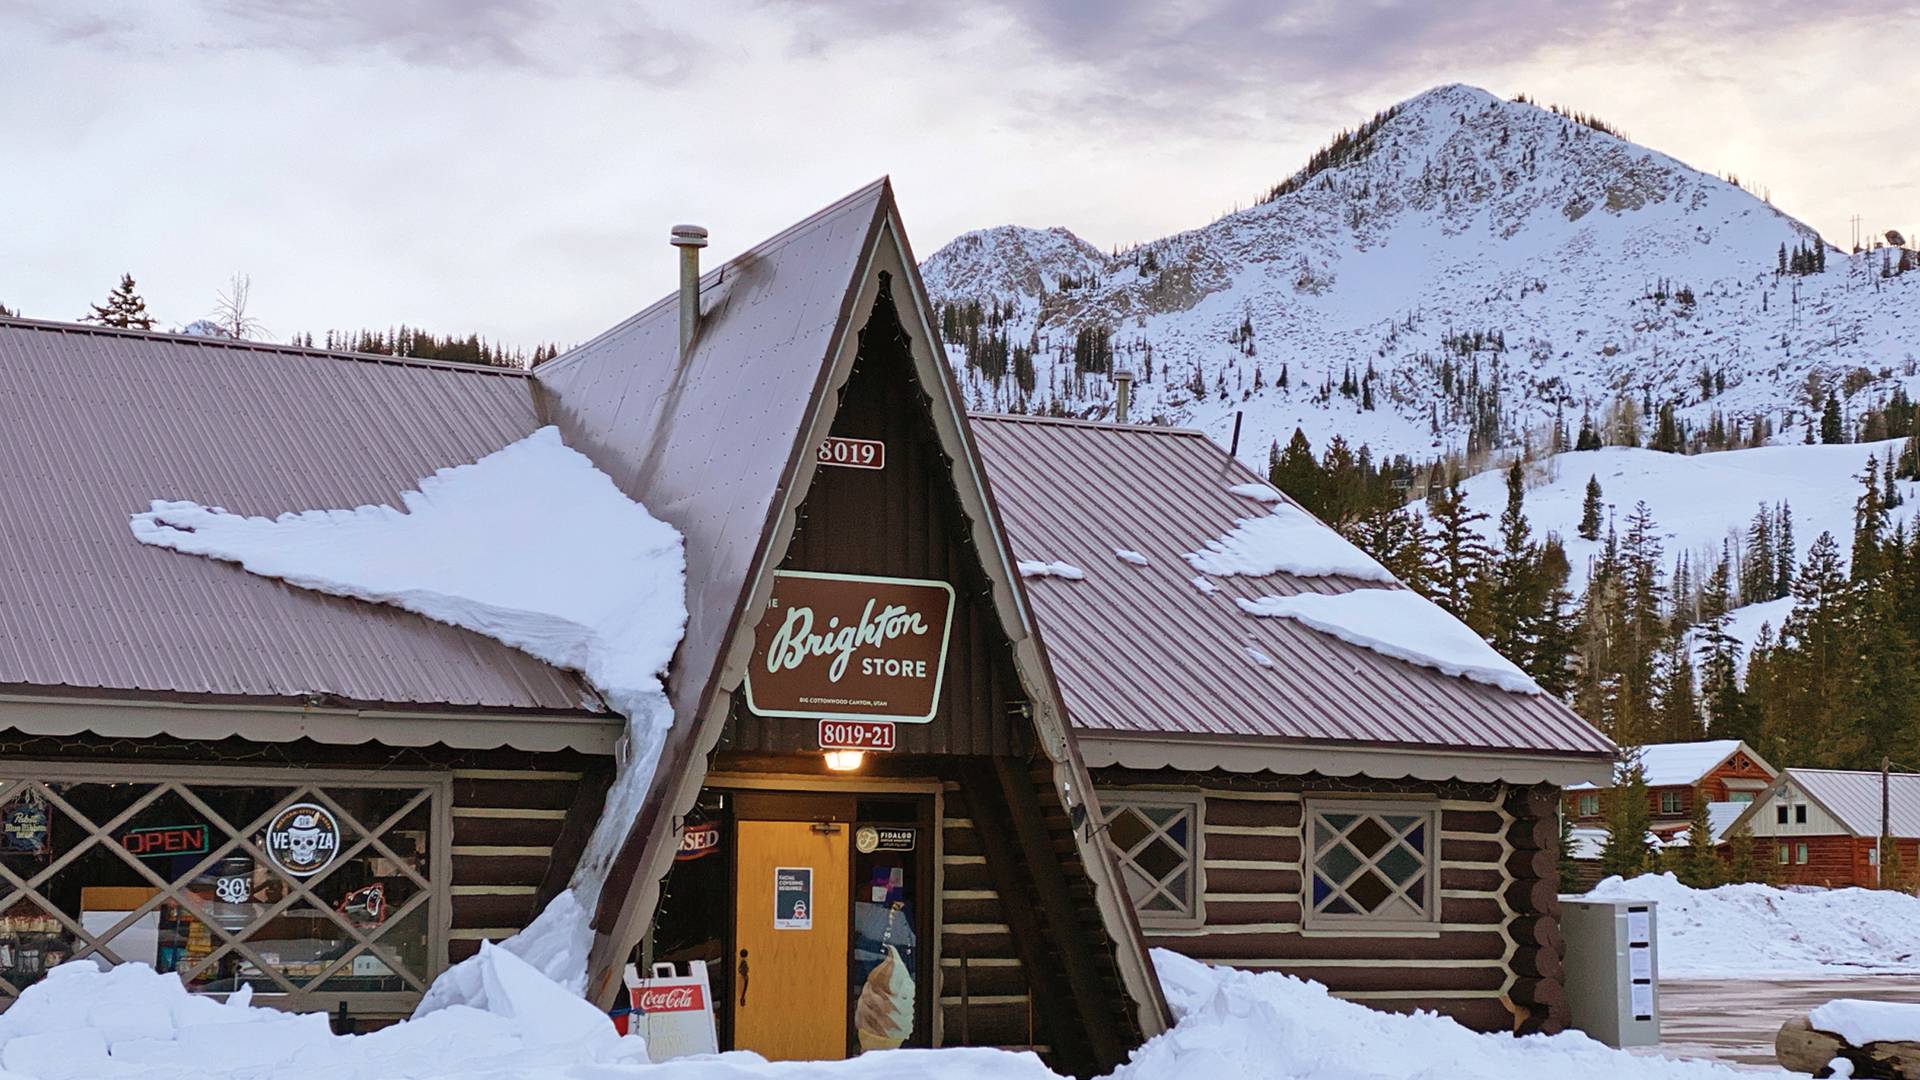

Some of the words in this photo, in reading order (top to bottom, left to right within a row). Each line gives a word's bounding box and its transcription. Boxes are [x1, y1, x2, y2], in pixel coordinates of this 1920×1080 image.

[819, 441, 875, 464] 8019
[767, 599, 928, 683] Brighton
[862, 658, 926, 678] STORE
[809, 697, 848, 705] COTTONWOOD
[824, 724, 890, 745] 8019-21
[123, 829, 202, 853] OPEN
[678, 830, 720, 850] SED
[641, 988, 694, 1010] Coca-Cola
